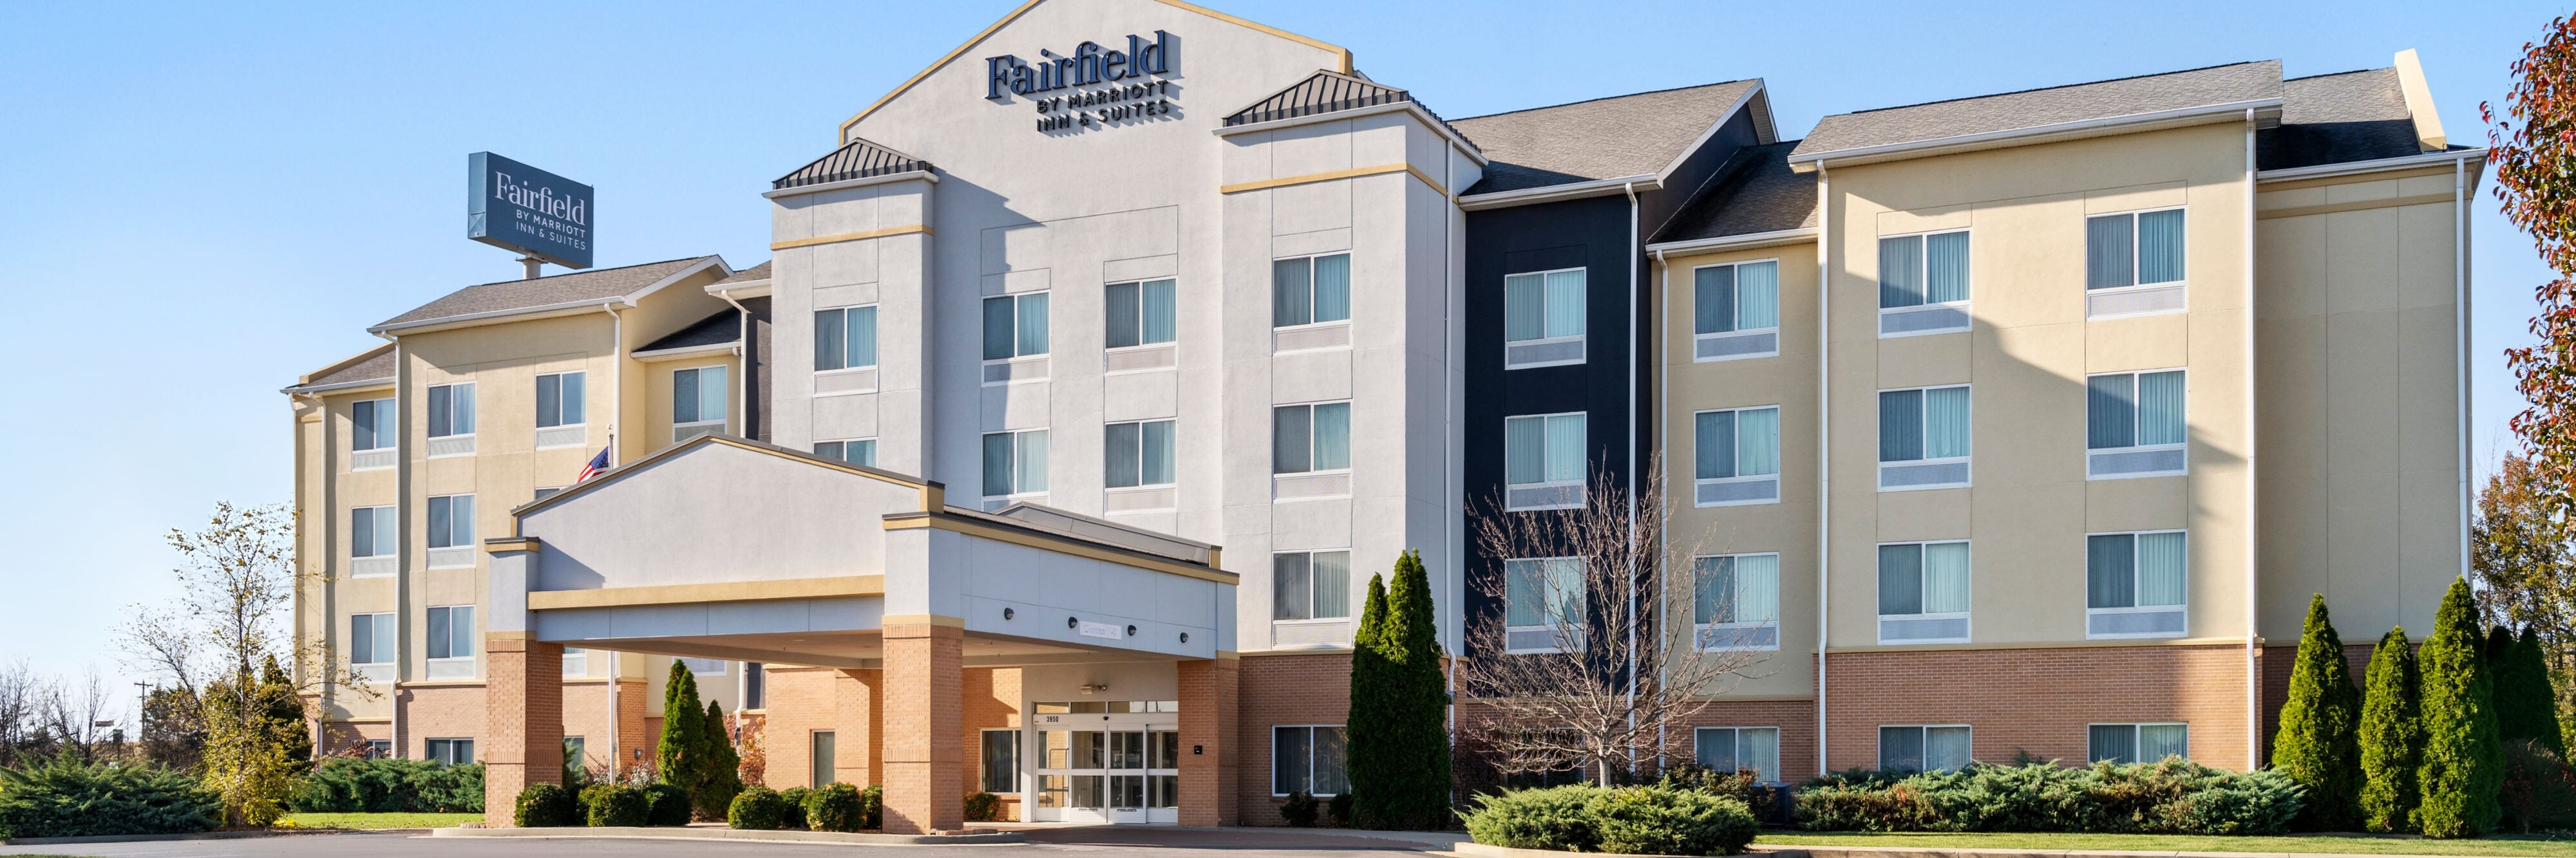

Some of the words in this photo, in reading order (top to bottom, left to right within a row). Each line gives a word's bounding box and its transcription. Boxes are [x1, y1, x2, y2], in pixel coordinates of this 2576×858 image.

[985, 30, 1168, 99] Fairfield
[1037, 97, 1061, 113] BY
[1068, 79, 1168, 109] MARRIOTT
[1037, 114, 1070, 132] INN
[1078, 113, 1090, 126] &
[1098, 98, 1168, 123] SUITES
[495, 171, 585, 226] Fairfield
[516, 209, 529, 221] BY
[534, 214, 586, 239] MARRIOTT
[516, 221, 535, 235] INN
[539, 228, 545, 238] &
[550, 232, 586, 250] SUITES
